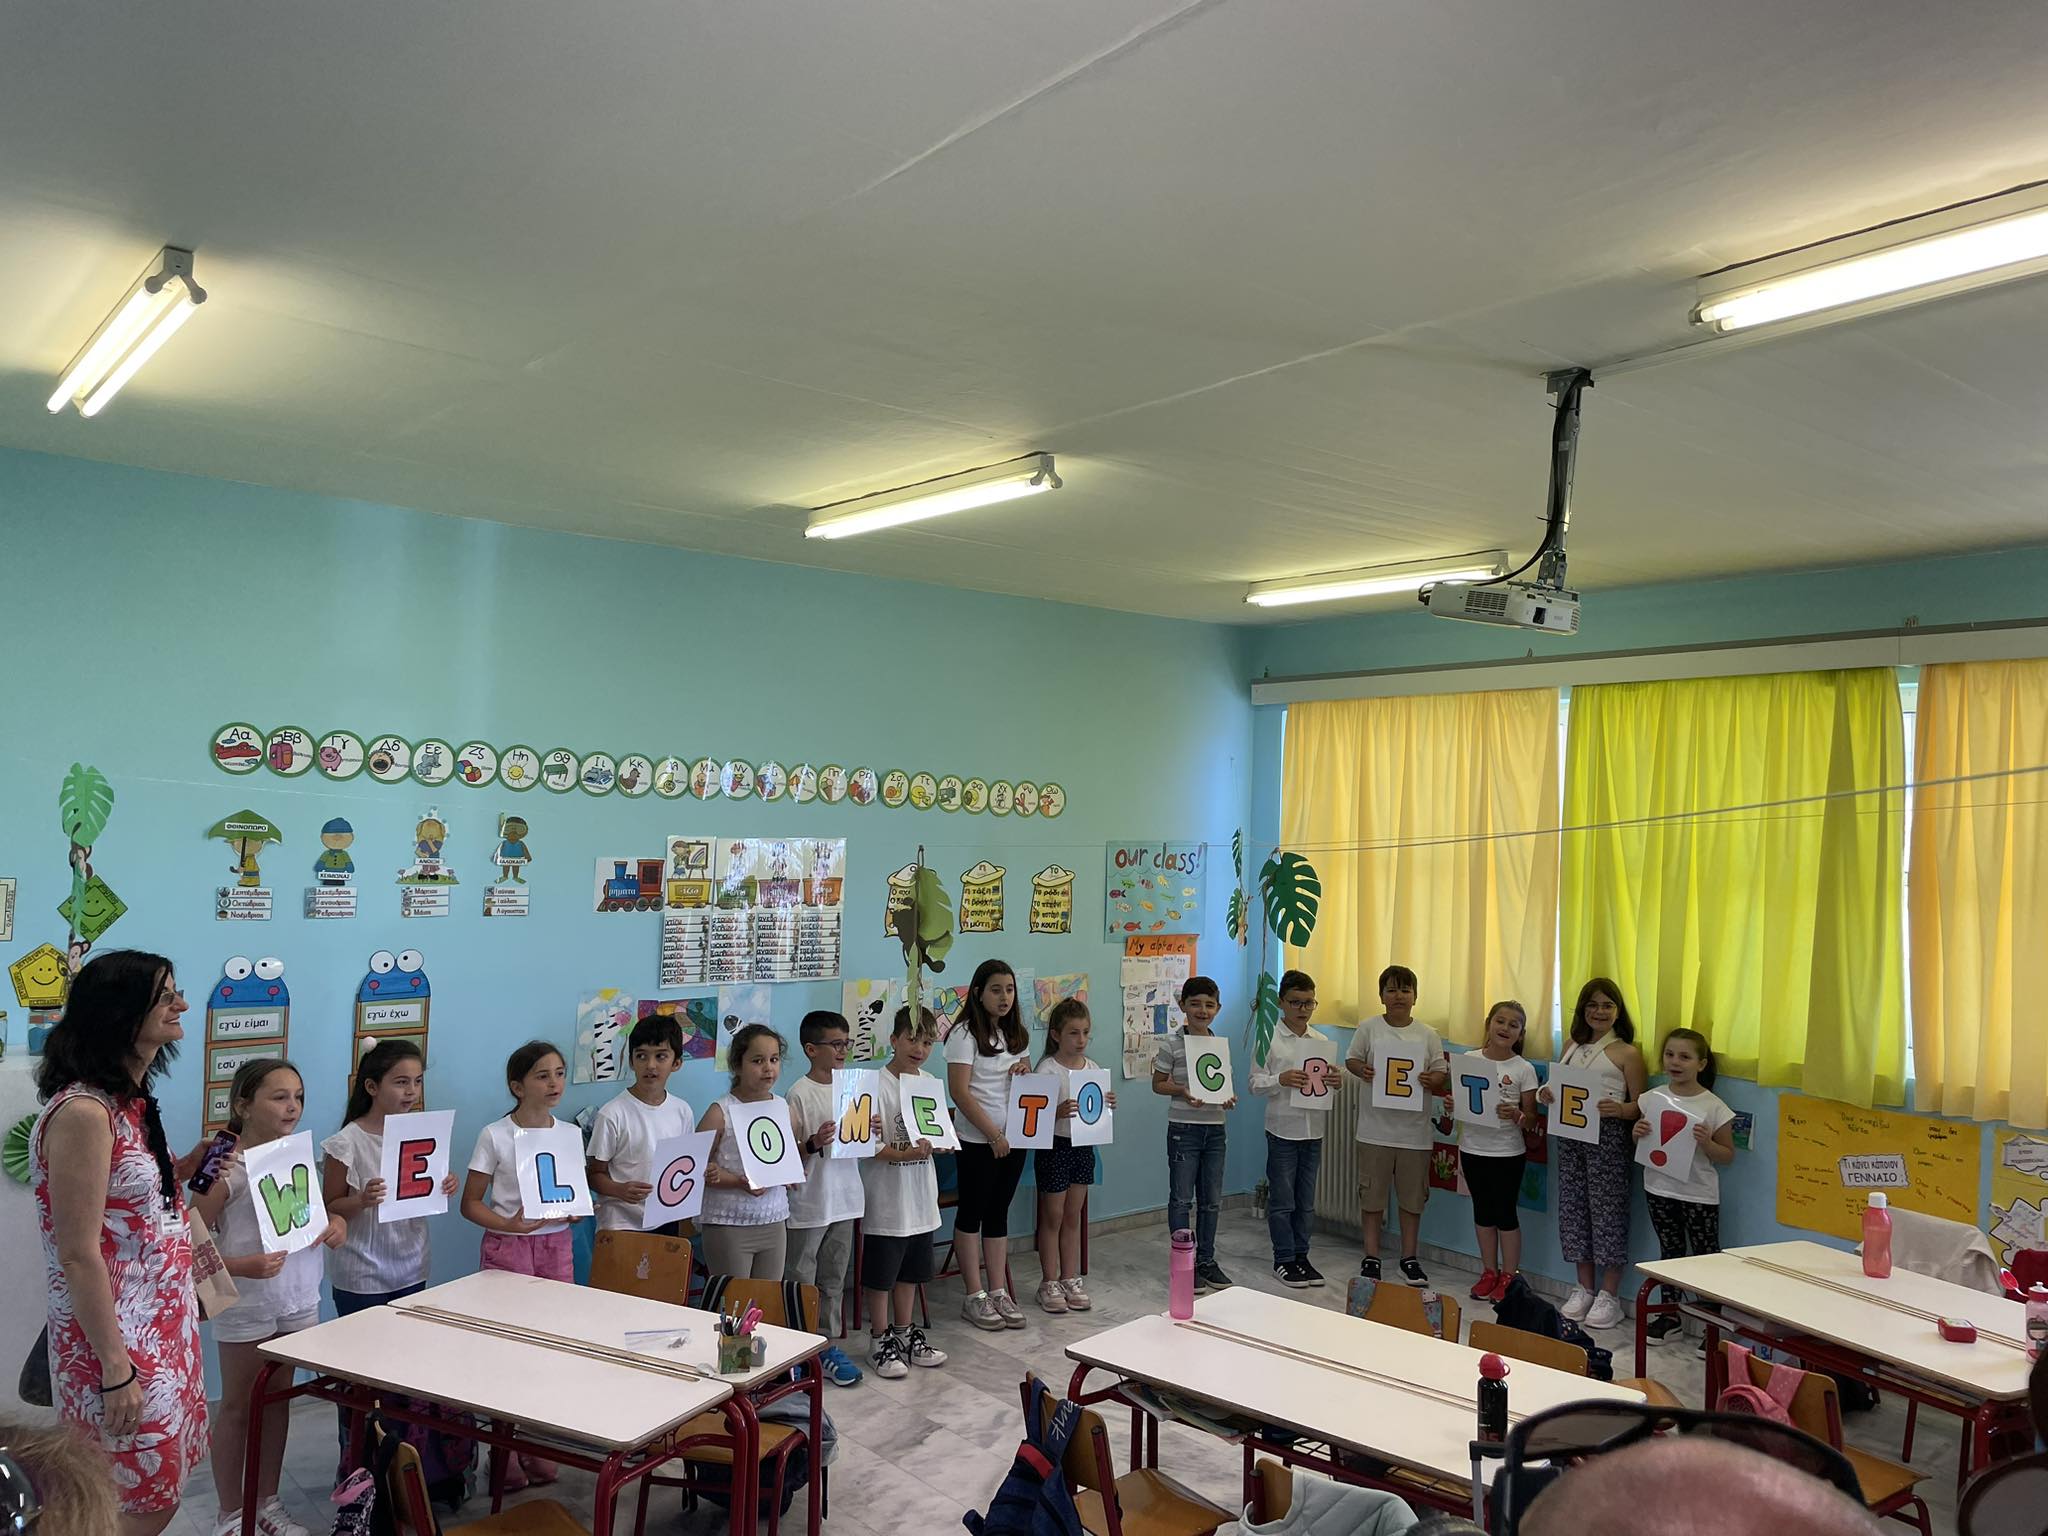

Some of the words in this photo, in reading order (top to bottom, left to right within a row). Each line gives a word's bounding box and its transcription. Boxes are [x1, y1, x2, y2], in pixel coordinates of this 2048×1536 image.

[230, 728, 252, 740] Αα
[379, 740, 400, 751] Δδ
[425, 744, 442, 755] Εε
[1153, 842, 1203, 875] class!
[1129, 938, 1145, 955] My
[367, 1009, 387, 1021] εγώ
[389, 1008, 409, 1019] έχω
[218, 1019, 241, 1031] εγώ
[244, 1019, 269, 1030] είμαι
[217, 1058, 236, 1070] εσύ
[1196, 1053, 1225, 1092] C
[1300, 1057, 1329, 1097] R
[1385, 1057, 1415, 1097] E
[1460, 1074, 1490, 1115] T
[1559, 1083, 1589, 1128] E
[1018, 1094, 1049, 1137] T
[1076, 1081, 1104, 1125] O
[258, 1163, 311, 1237] W
[396, 1138, 437, 1201] E
[535, 1152, 575, 1204] L
[657, 1155, 696, 1207] C
[748, 1116, 785, 1164] O
[839, 1093, 873, 1144] M
[911, 1095, 944, 1136] E
[1853, 1158, 1870, 1169] κάνει
[1848, 1172, 1898, 1183] ΓΕΝΝΑΙΟ
